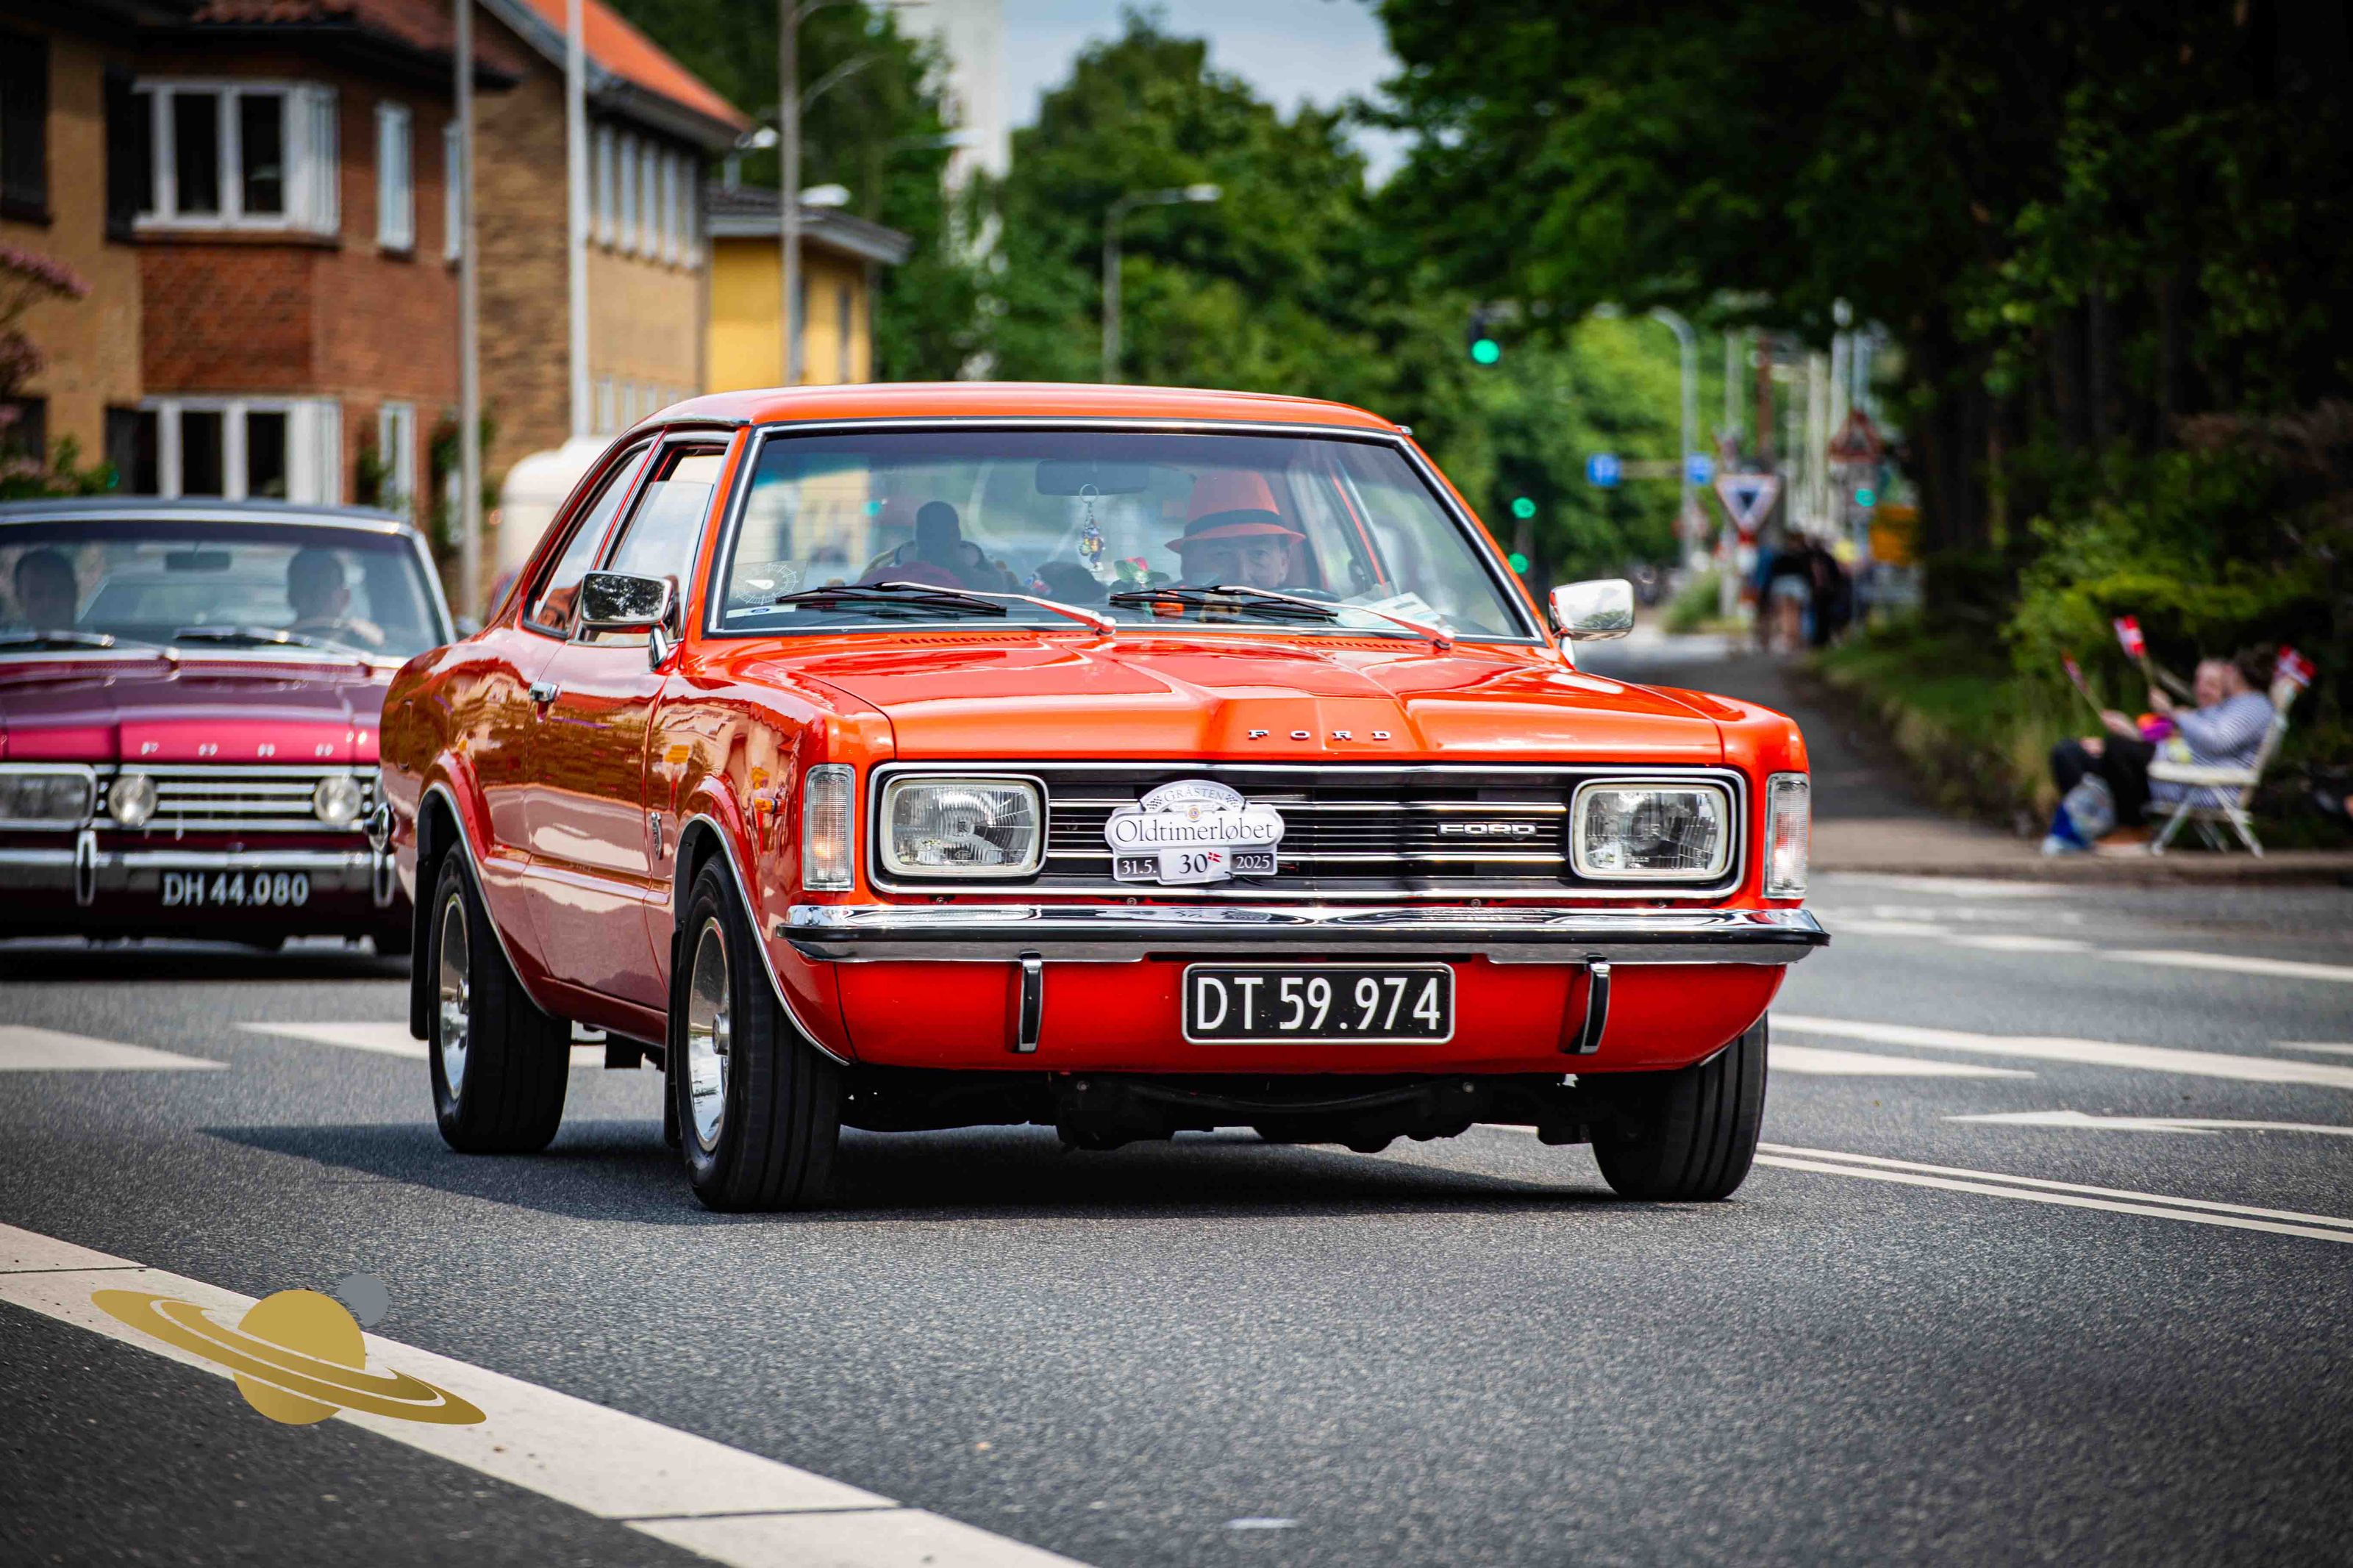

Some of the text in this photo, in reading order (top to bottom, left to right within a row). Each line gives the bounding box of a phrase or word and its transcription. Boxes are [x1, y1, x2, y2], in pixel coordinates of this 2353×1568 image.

[1248, 729, 1391, 740] FORD
[1164, 786, 1224, 802] GRÅSTEN
[1115, 817, 1274, 842] Oldtimerløbet
[1440, 823, 1537, 835] FORD
[1121, 859, 1157, 875] 31.5.
[1179, 853, 1208, 874] 30
[1235, 854, 1271, 870] 2025
[162, 872, 309, 906] DH 44.080
[1196, 977, 1441, 1030] DT 59.974
